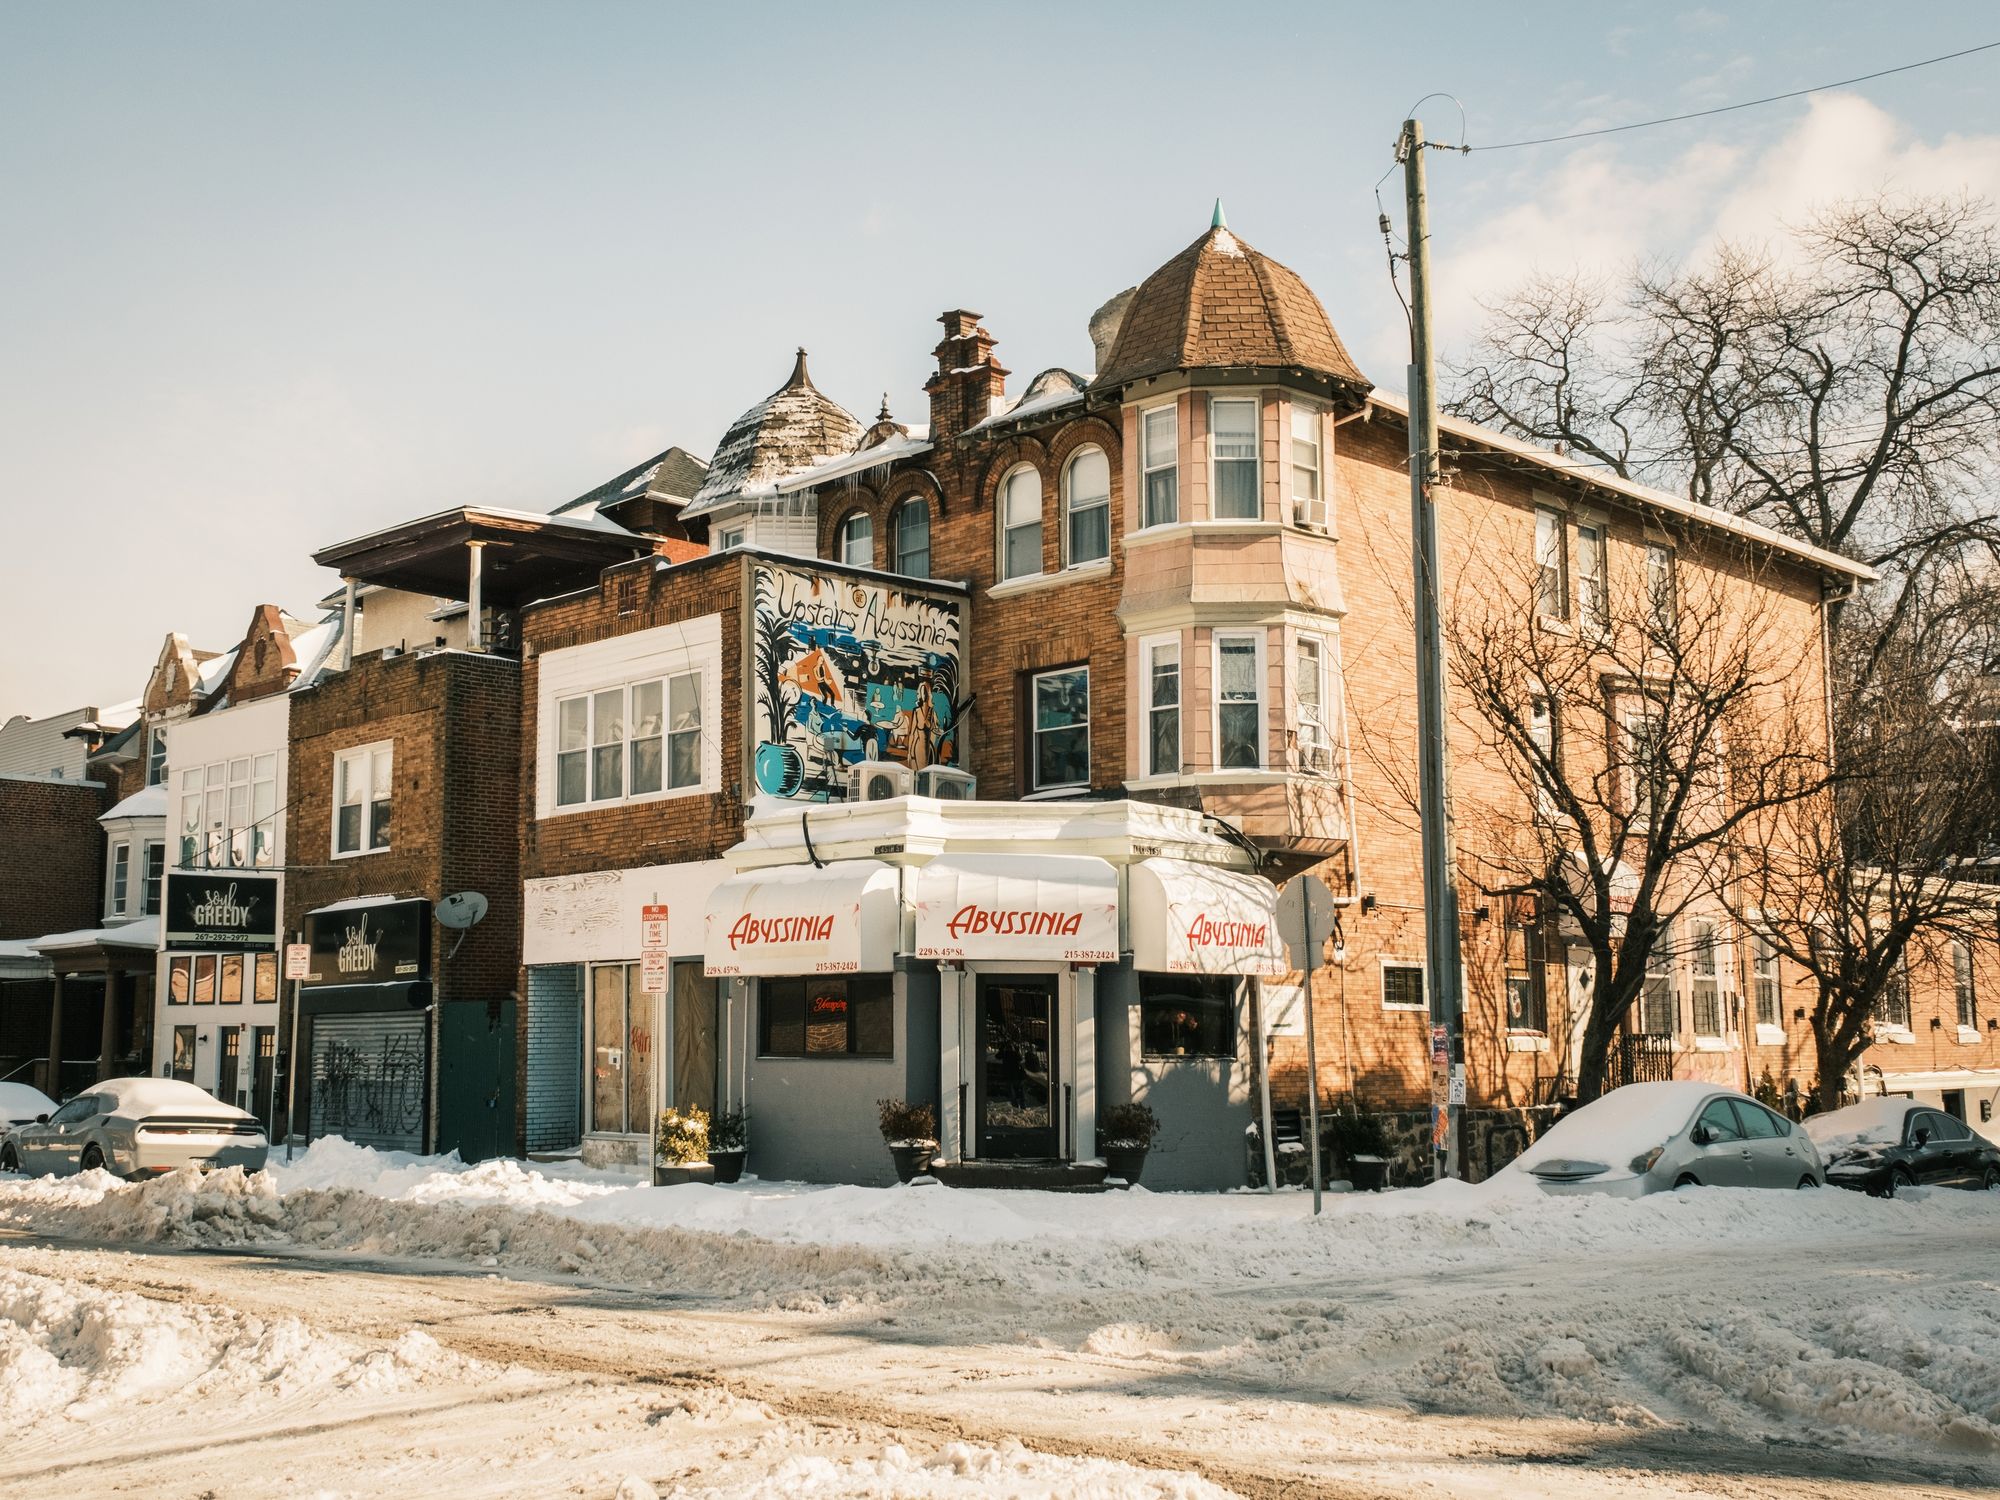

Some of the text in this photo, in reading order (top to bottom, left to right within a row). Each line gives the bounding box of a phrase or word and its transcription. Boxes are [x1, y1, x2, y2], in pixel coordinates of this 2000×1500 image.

[777, 572, 860, 635] Upstairs
[862, 591, 948, 648] Abyssinia
[194, 905, 250, 927] GREEDY
[946, 905, 1083, 939] ABYSSINIA
[195, 933, 249, 941] 267-292-2972
[728, 913, 834, 951] ABYSSINIA
[1186, 913, 1266, 952] ABYSSINIA
[339, 943, 377, 972] GREEDY
[918, 948, 933, 956] 229
[933, 948, 940, 956] S.
[1064, 950, 1115, 959] 215-387-2424
[706, 966, 716, 974] 229
[815, 962, 858, 972] 215-387-2424
